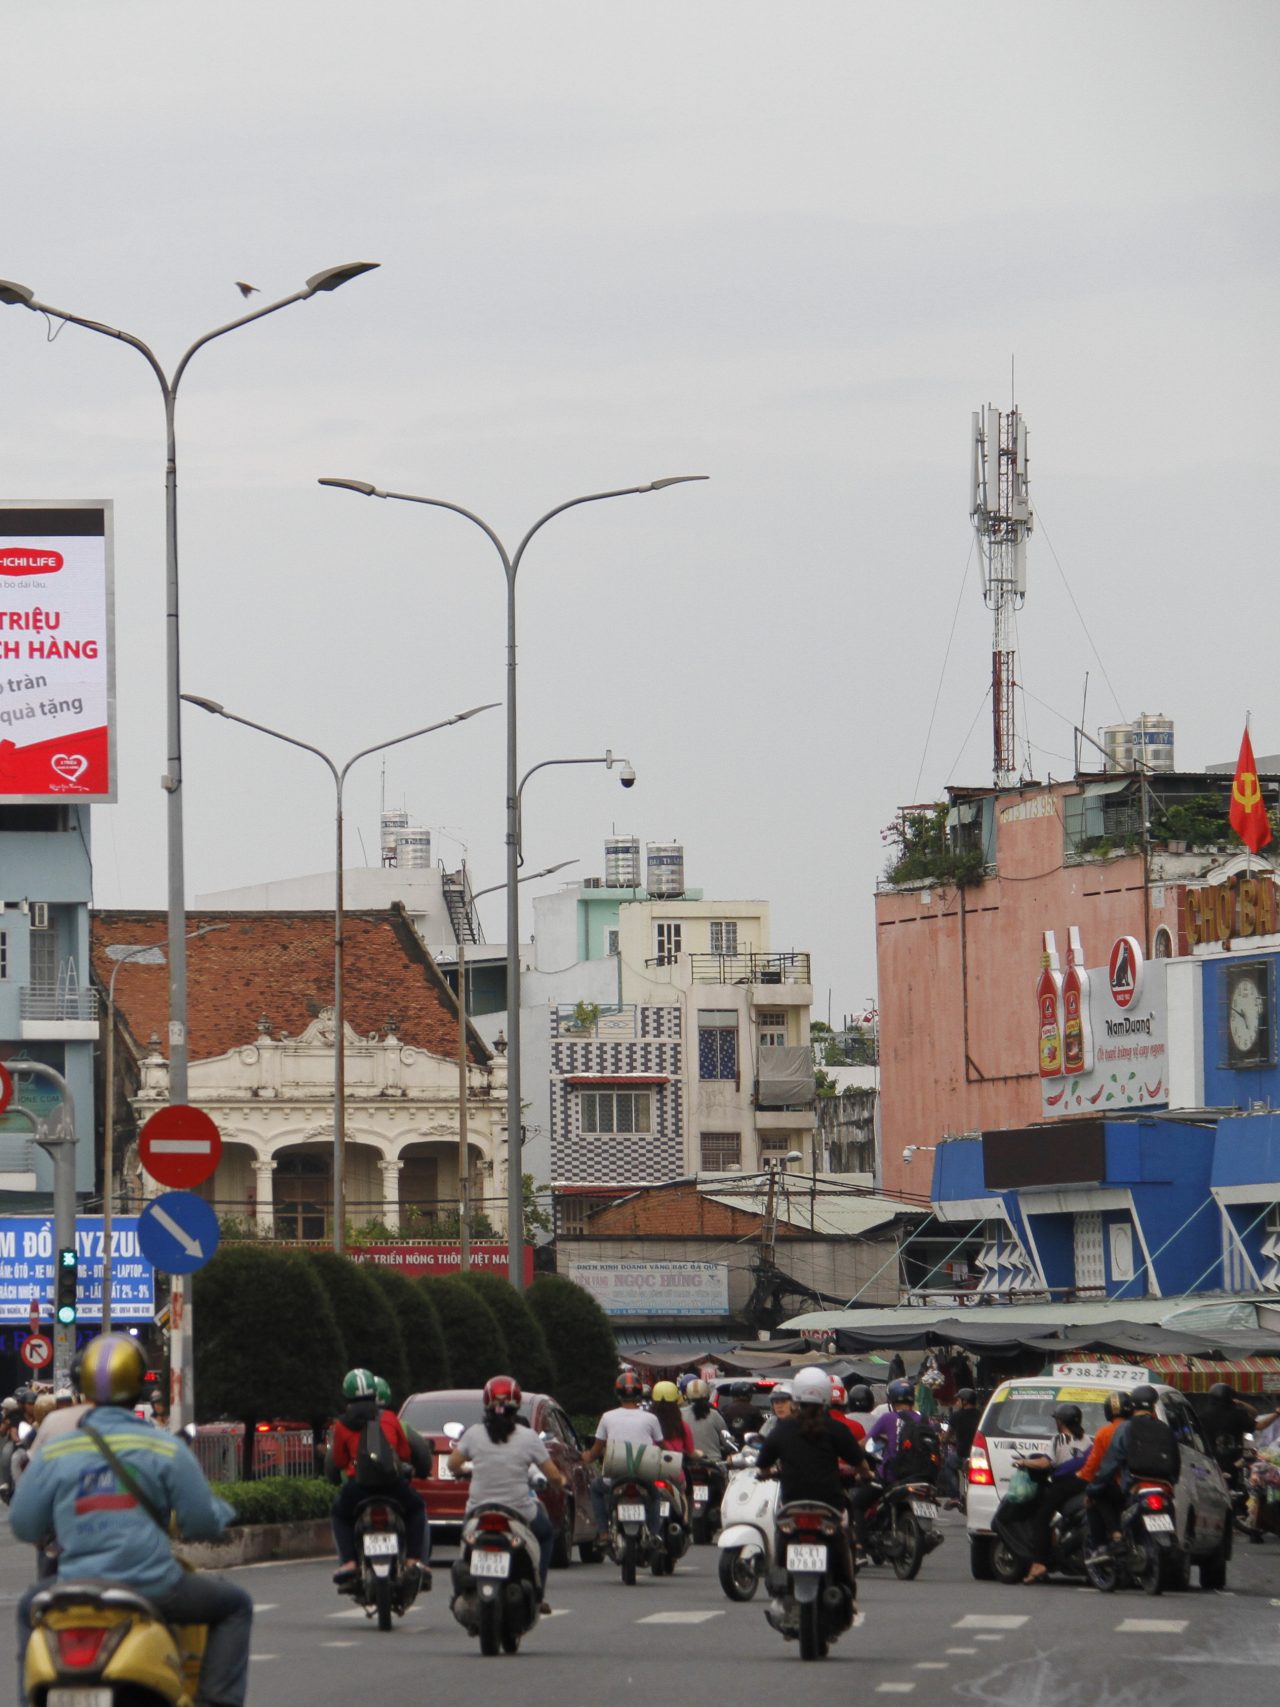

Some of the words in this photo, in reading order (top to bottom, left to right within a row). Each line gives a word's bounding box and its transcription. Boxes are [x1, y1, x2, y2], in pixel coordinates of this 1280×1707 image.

[29, 557, 57, 567] LIFE
[27, 636, 99, 660] HÀNG
[7, 675, 48, 693] tràn
[0, 701, 37, 727] quà
[38, 696, 85, 719] tặng
[23, 1221, 52, 1258] ĐỒ
[374, 1250, 403, 1265] TRIỂN
[405, 1252, 434, 1265] NÔNG
[468, 1252, 489, 1267] VIỆT
[492, 1254, 510, 1265] NA
[35, 1265, 45, 1279] XE
[614, 1274, 657, 1289] NGỌC
[1113, 1368, 1127, 1379] 27
[1130, 1370, 1145, 1380] 27
[993, 1440, 1039, 1451] VISUN
